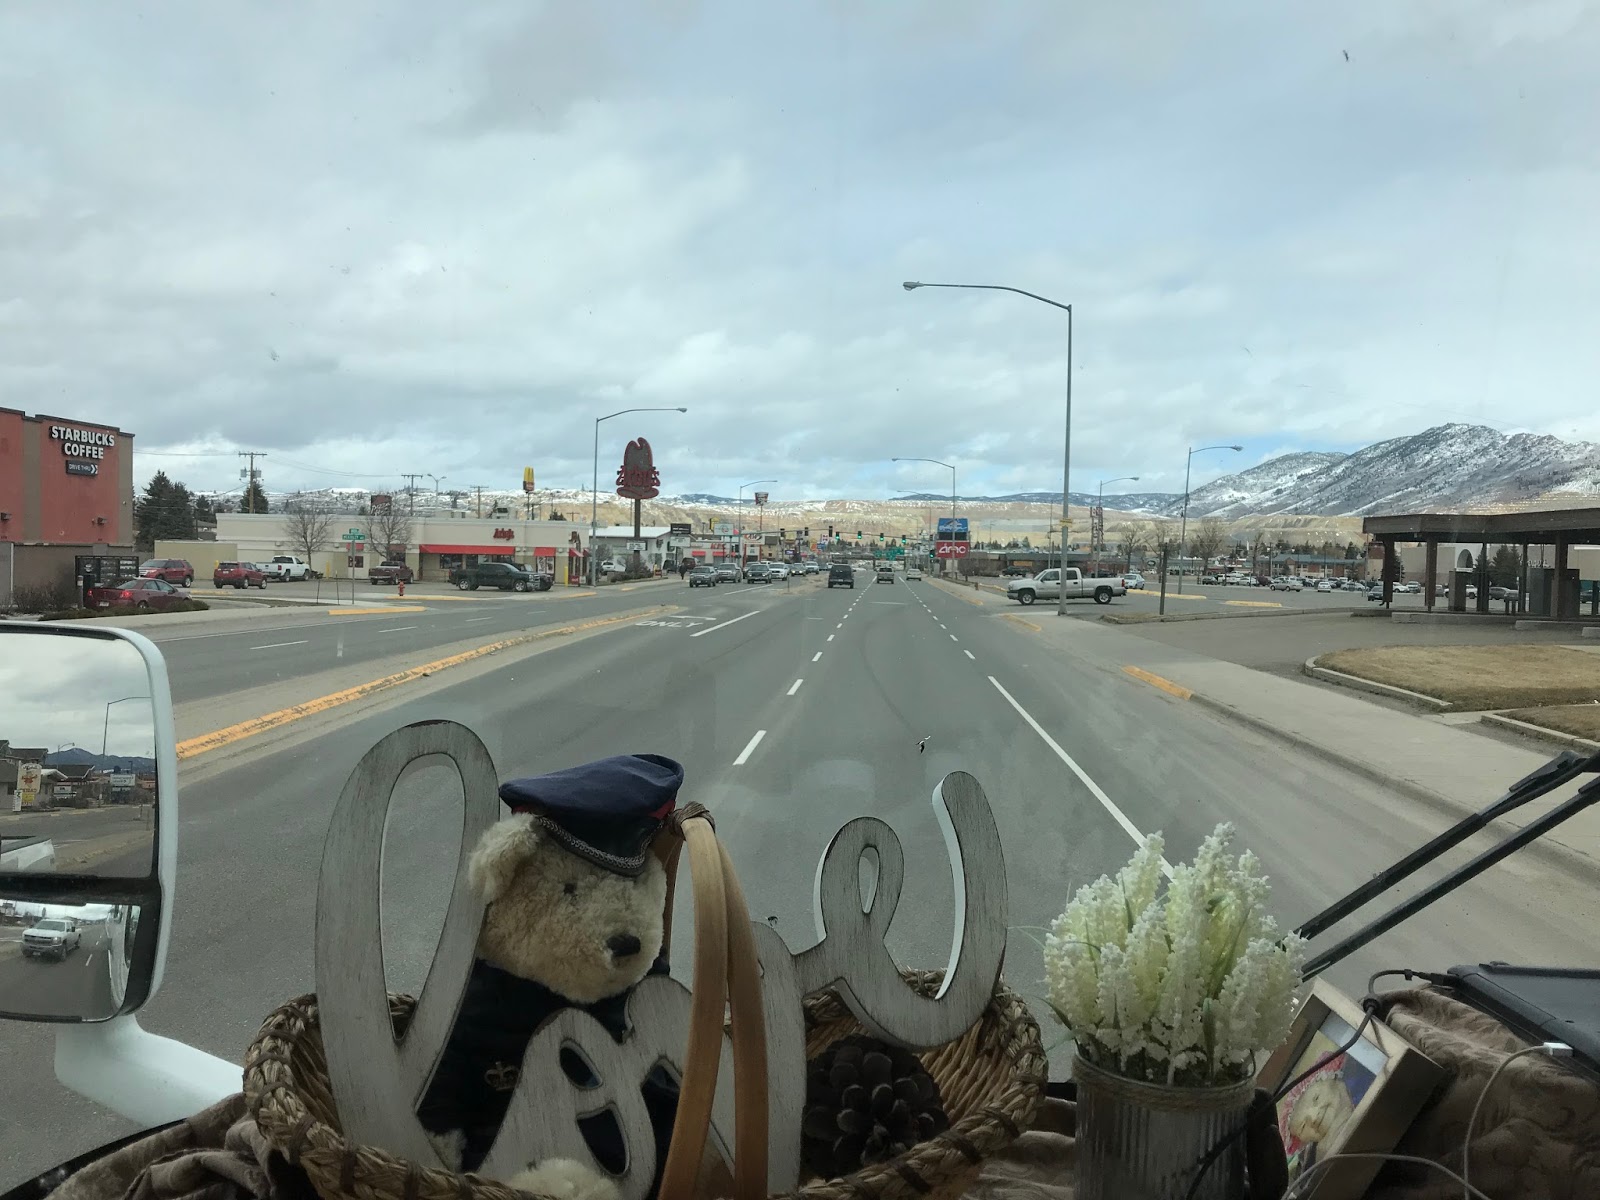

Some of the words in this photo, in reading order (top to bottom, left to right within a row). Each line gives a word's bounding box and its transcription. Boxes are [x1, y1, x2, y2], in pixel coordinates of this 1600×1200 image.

[51, 425, 115, 447] STARBUCKS
[64, 442, 104, 459] COFFEE
[68, 463, 81, 471] DRIVE
[81, 464, 91, 472] THRU
[616, 465, 660, 492] Arby's
[493, 528, 515, 541] Arby's
[635, 620, 703, 628] ONLY
